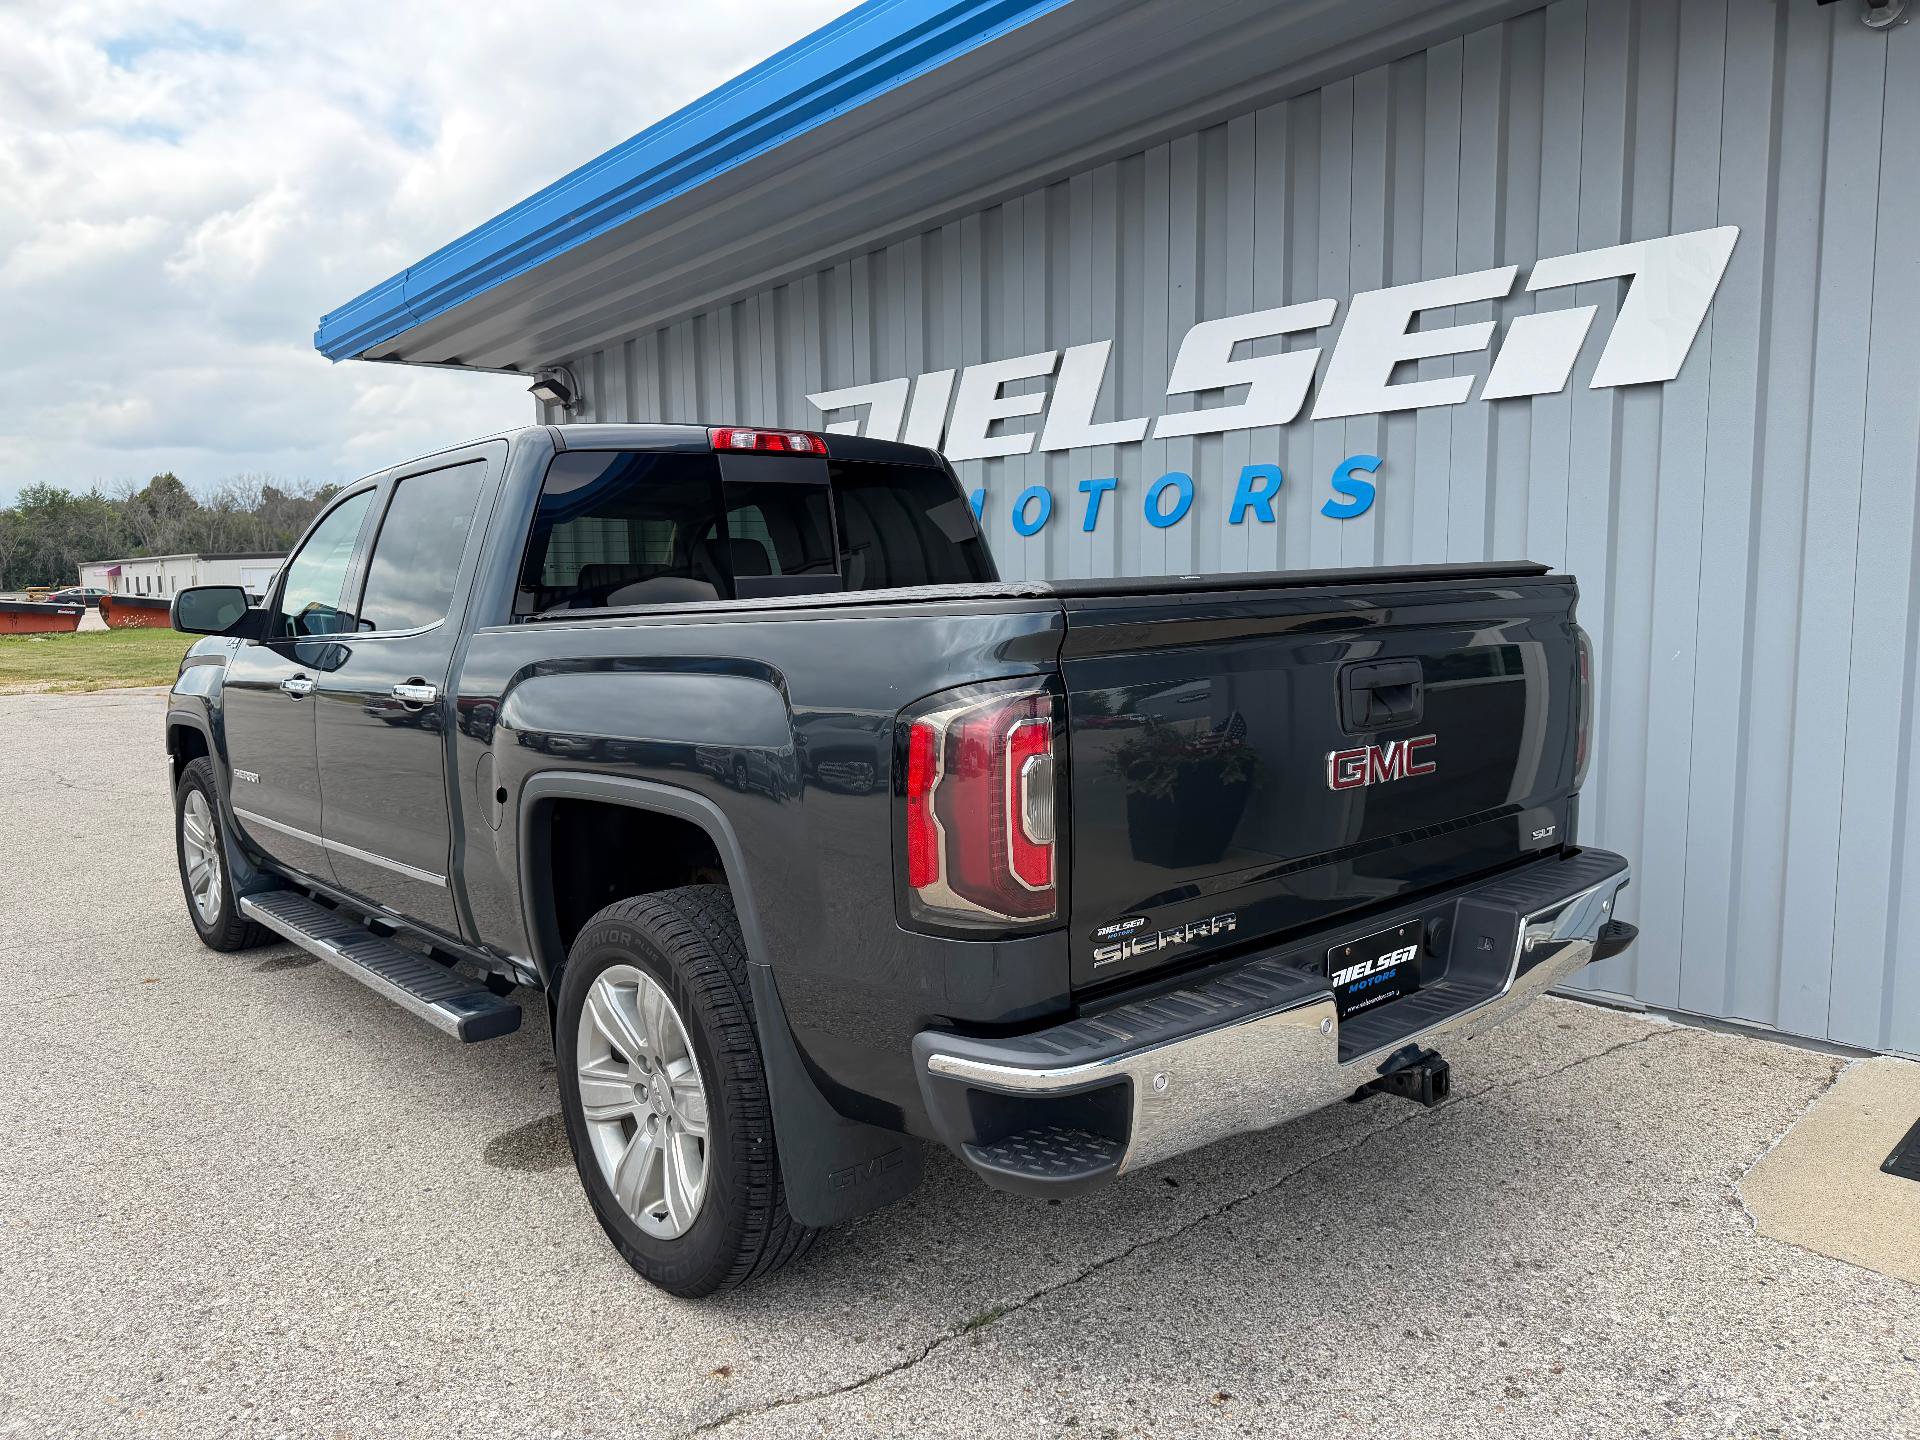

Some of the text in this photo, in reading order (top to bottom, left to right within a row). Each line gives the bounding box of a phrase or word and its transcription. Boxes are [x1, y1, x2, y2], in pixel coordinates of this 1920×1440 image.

[1326, 734, 1437, 790] GMC
[1532, 825, 1556, 841] SLT
[1093, 912, 1237, 969] SIERRA
[1107, 929, 1135, 940] MOTORS
[1331, 945, 1418, 988] NIELSEN
[1349, 968, 1397, 993] MOTORS
